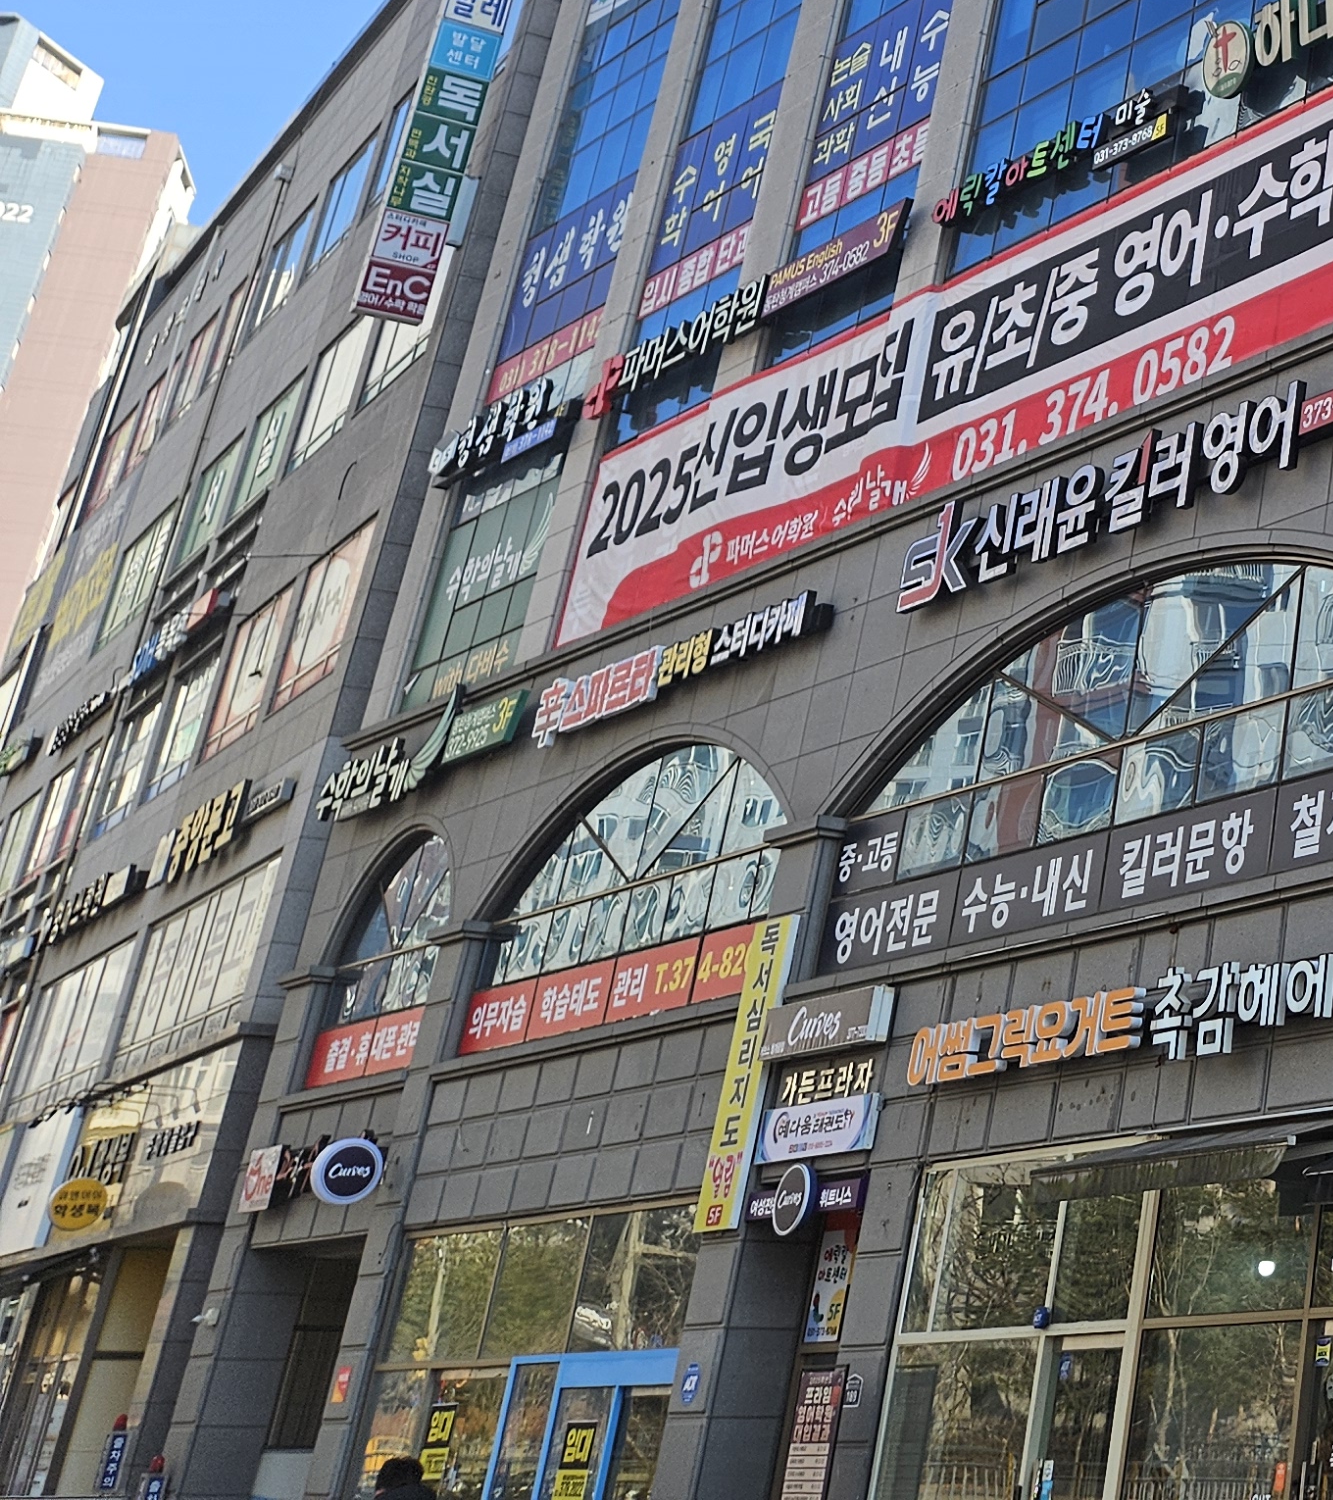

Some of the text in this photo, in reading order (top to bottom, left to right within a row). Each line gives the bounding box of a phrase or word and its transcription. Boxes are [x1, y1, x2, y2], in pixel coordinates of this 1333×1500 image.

[446, 48, 482, 70] 센터
[451, 30, 488, 52] 발달
[829, 41, 873, 89] 논술
[910, 9, 951, 103] 수능
[822, 77, 863, 123] 사회
[866, 25, 909, 131] 내신
[1114, 87, 1152, 128] 미술
[740, 109, 777, 200] 국어
[813, 121, 856, 166] 과학
[701, 132, 738, 223] 영어
[799, 145, 890, 230] 고등 중등
[660, 164, 698, 247] 수학
[381, 222, 443, 258] 커피
[391, 250, 420, 264] SHOP
[769, 209, 899, 292] PAMUS English 3F
[364, 264, 431, 300] EnC
[638, 243, 716, 318] 입시 종합
[1130, 314, 1236, 405] 0582
[724, 509, 820, 565] 파머스어학원
[657, 590, 810, 688] 관리형 스터디카페
[492, 696, 517, 734] 3F
[838, 829, 900, 884] 중·고등
[832, 887, 941, 966] 영어전문
[1118, 807, 1256, 901] 킬러문항
[468, 961, 649, 1042] 의무자습 학습태도 관리
[786, 1005, 842, 1047] Curves
[905, 986, 1147, 1088] 어썸그릭요거트
[780, 1058, 876, 1107] 가든프라자
[327, 1161, 372, 1180] Curves
[707, 1204, 723, 1226] 5F
[818, 1183, 852, 1208] 휘트니스
[428, 1408, 456, 1446] 임대
[565, 1425, 595, 1465] 임대
